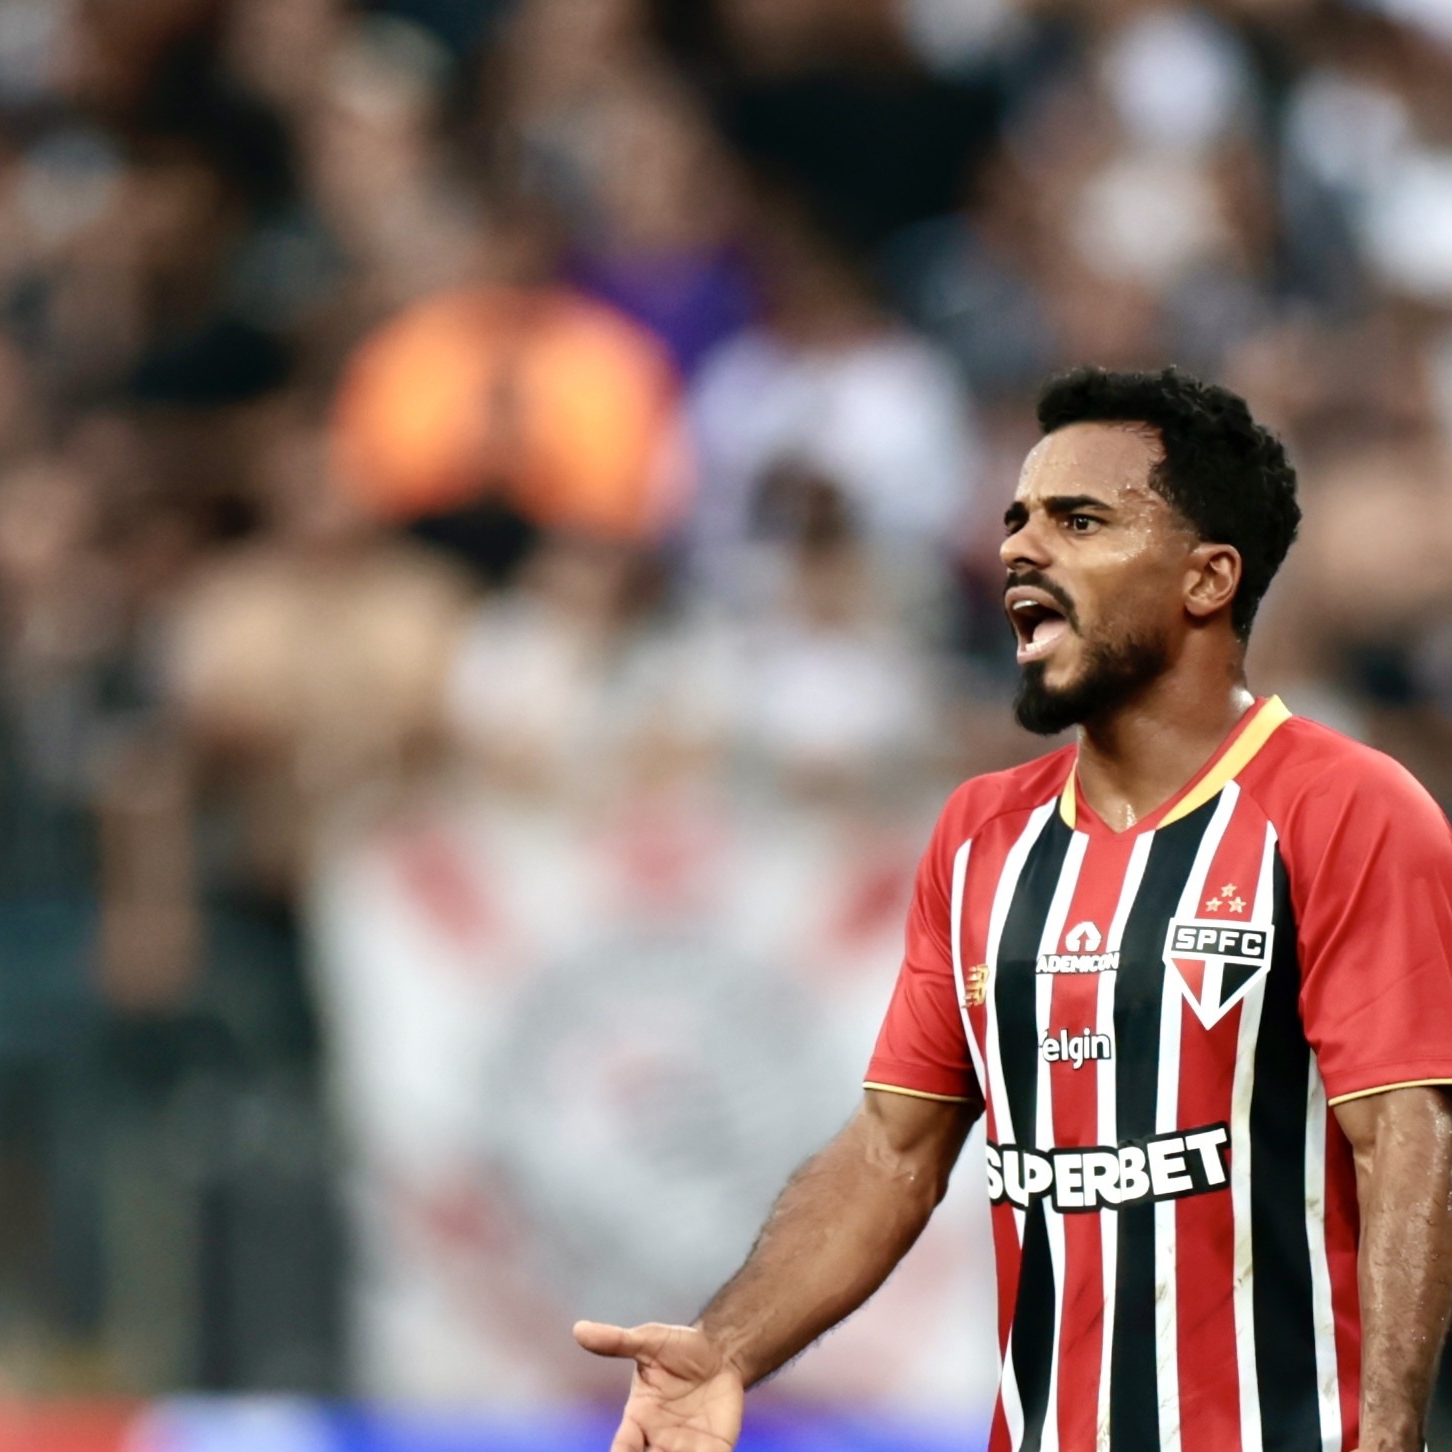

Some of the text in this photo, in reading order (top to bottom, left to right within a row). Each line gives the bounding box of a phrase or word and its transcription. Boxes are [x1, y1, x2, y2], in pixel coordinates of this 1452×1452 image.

[1175, 927, 1263, 956] SPFC
[1036, 952, 1119, 974] ADEMICON
[1042, 1027, 1111, 1070] elgin
[986, 1127, 1229, 1208] SUPERBET
